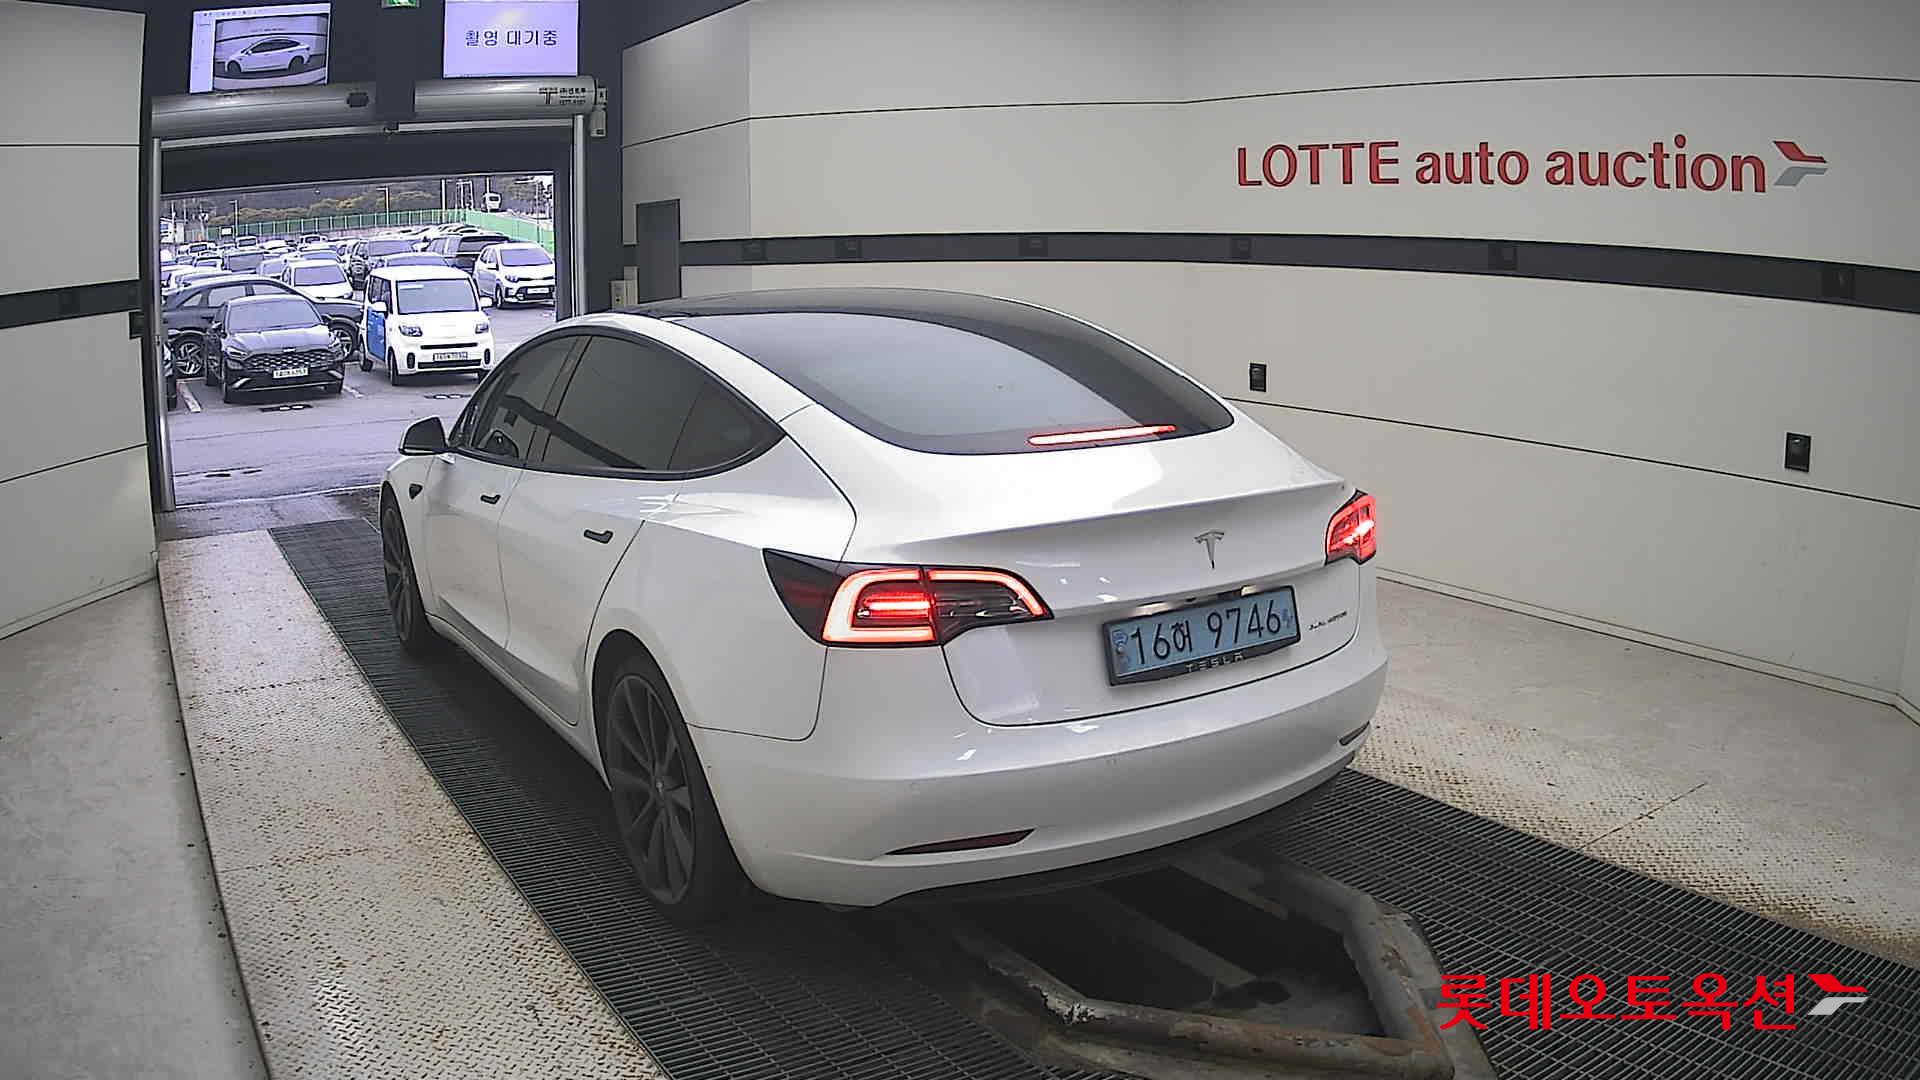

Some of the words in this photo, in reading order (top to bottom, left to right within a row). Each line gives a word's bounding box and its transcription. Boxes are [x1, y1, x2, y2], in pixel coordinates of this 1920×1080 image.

[465, 30, 498, 46] 촬영
[506, 30, 557, 46] 대기중
[1237, 141, 1400, 187] LOTTE
[1415, 140, 1530, 187] auto
[1544, 134, 1767, 193] auction
[1207, 600, 1282, 649] 9746
[1186, 653, 1245, 672] TESLA
